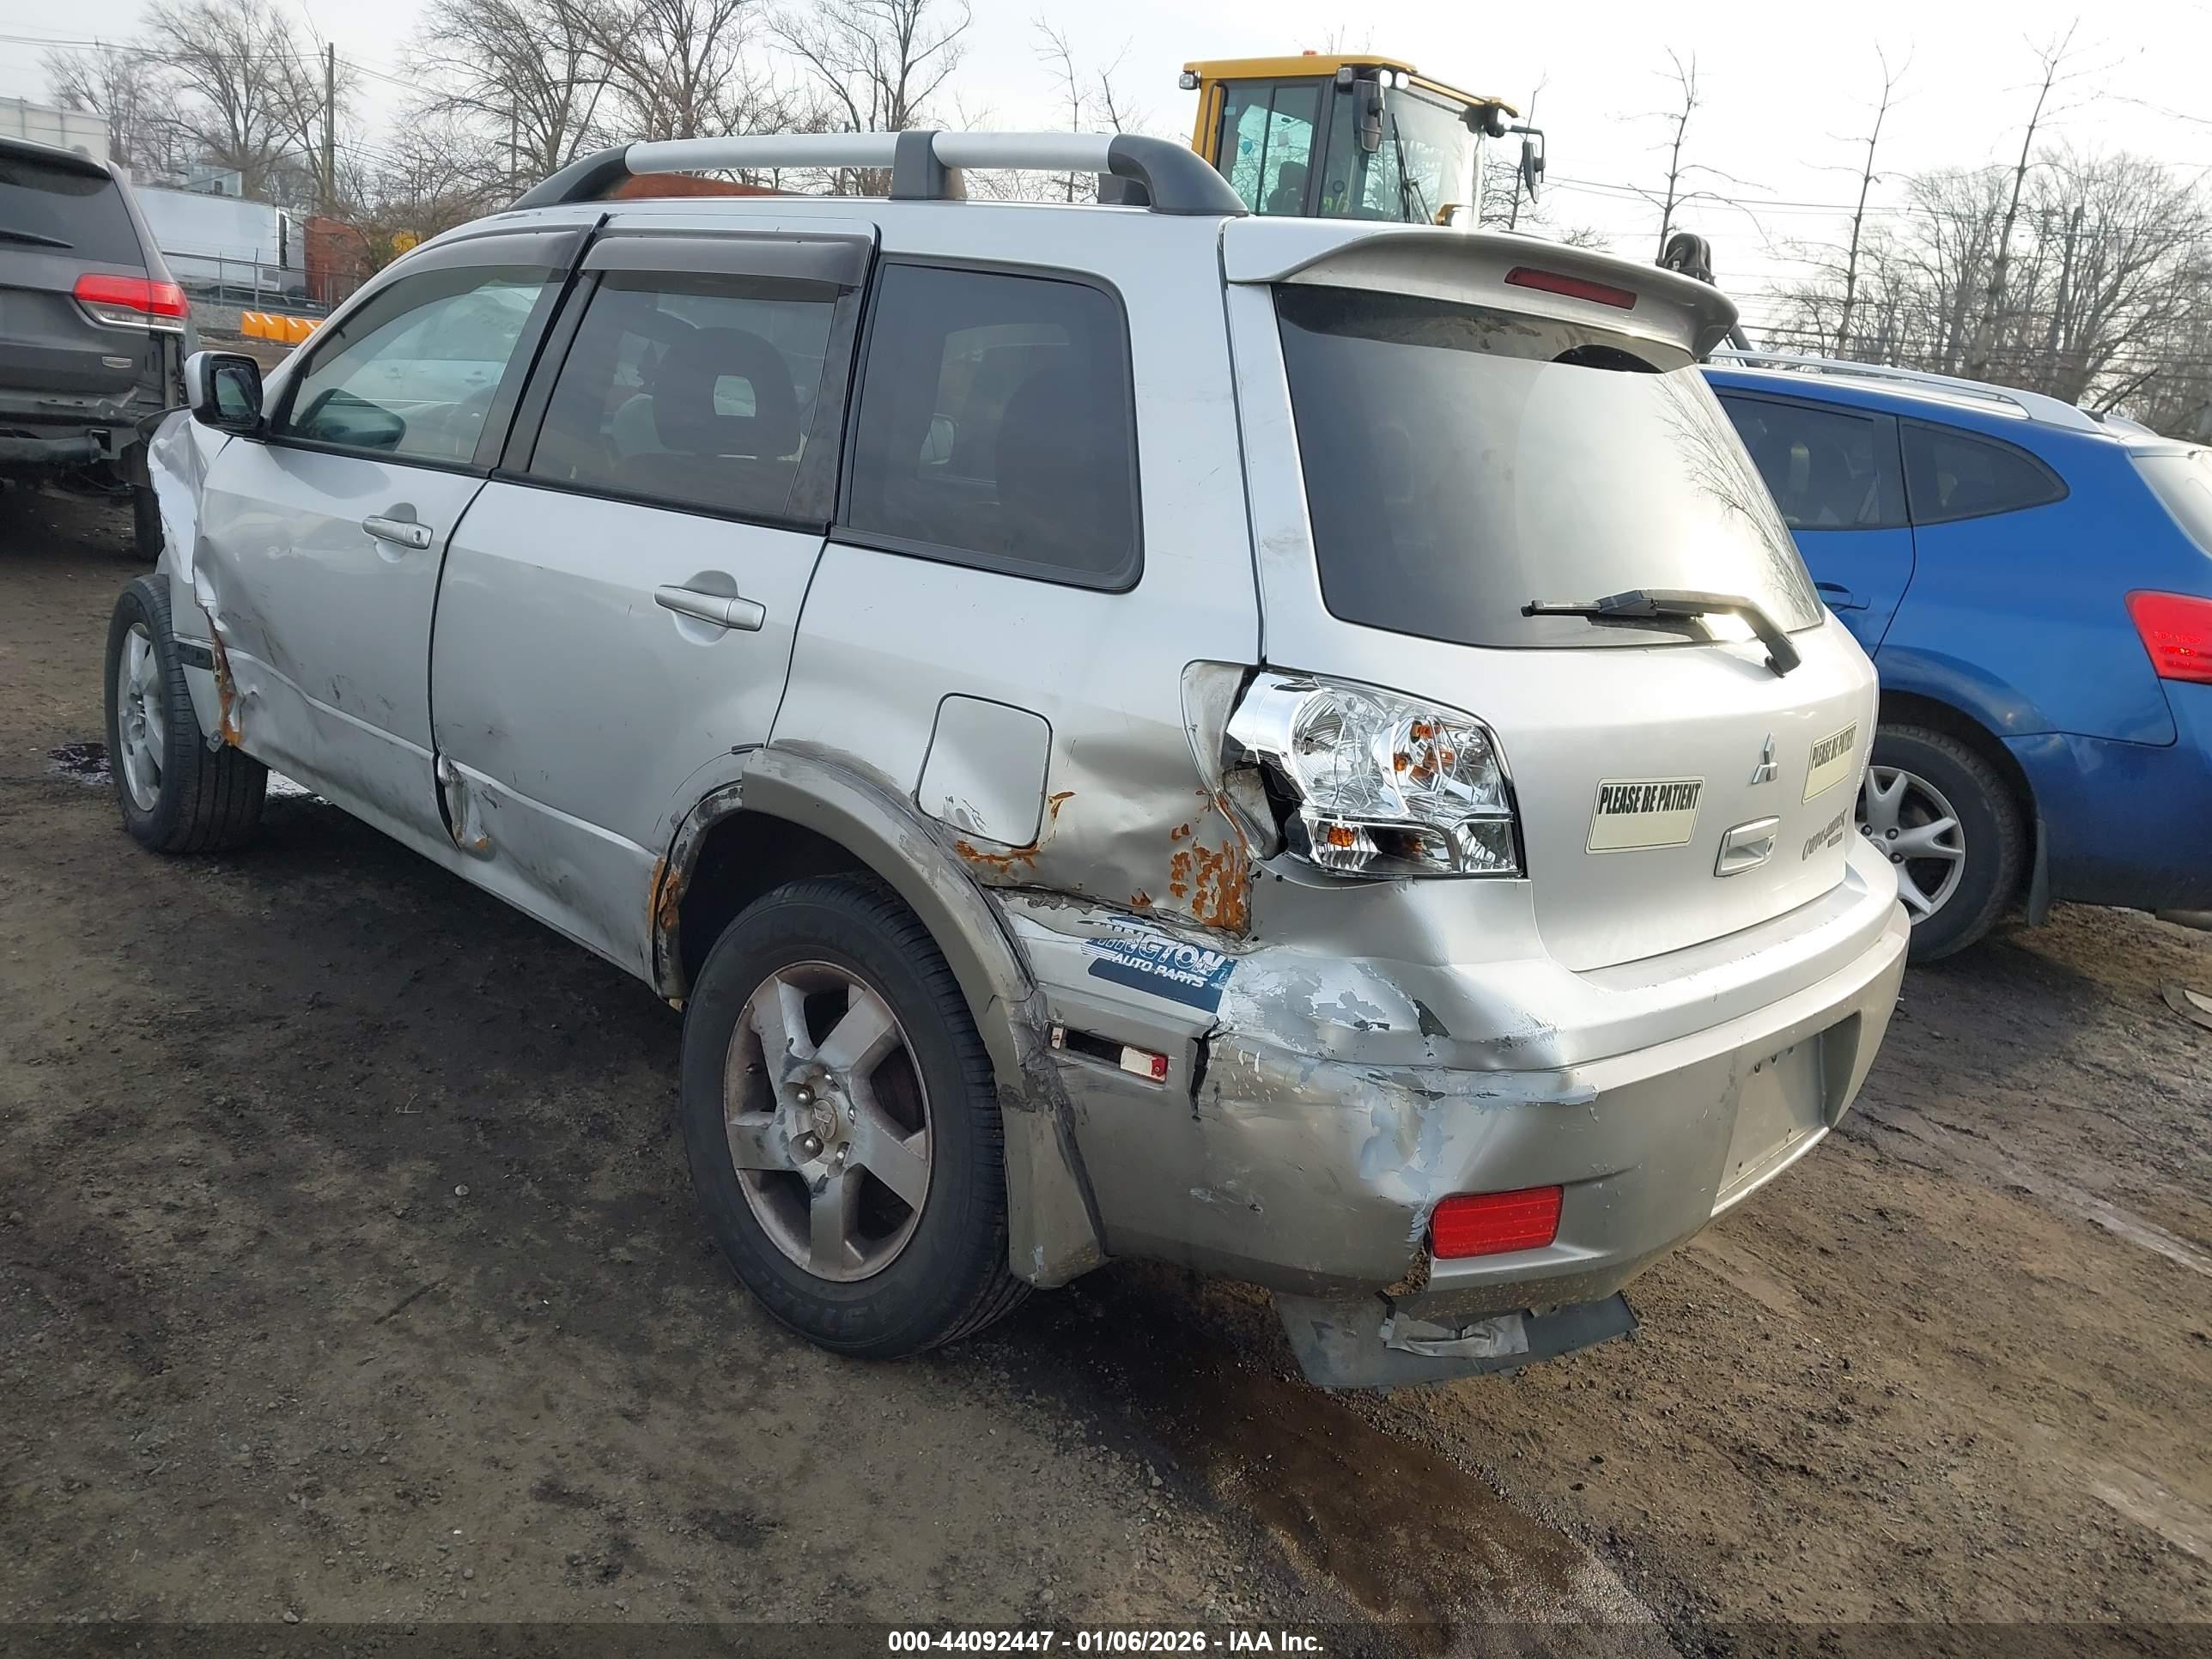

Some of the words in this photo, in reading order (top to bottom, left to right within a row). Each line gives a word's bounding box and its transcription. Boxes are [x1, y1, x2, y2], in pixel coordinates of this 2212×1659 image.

[1810, 738, 1832, 771] PLEASE
[1830, 735, 1840, 762] BE
[1598, 785, 1643, 815] PLEASE
[1640, 784, 1659, 813] BE
[1656, 782, 1702, 811] PATIENT
[1112, 953, 1153, 973] AUTO
[1153, 963, 1208, 988] PARTS
